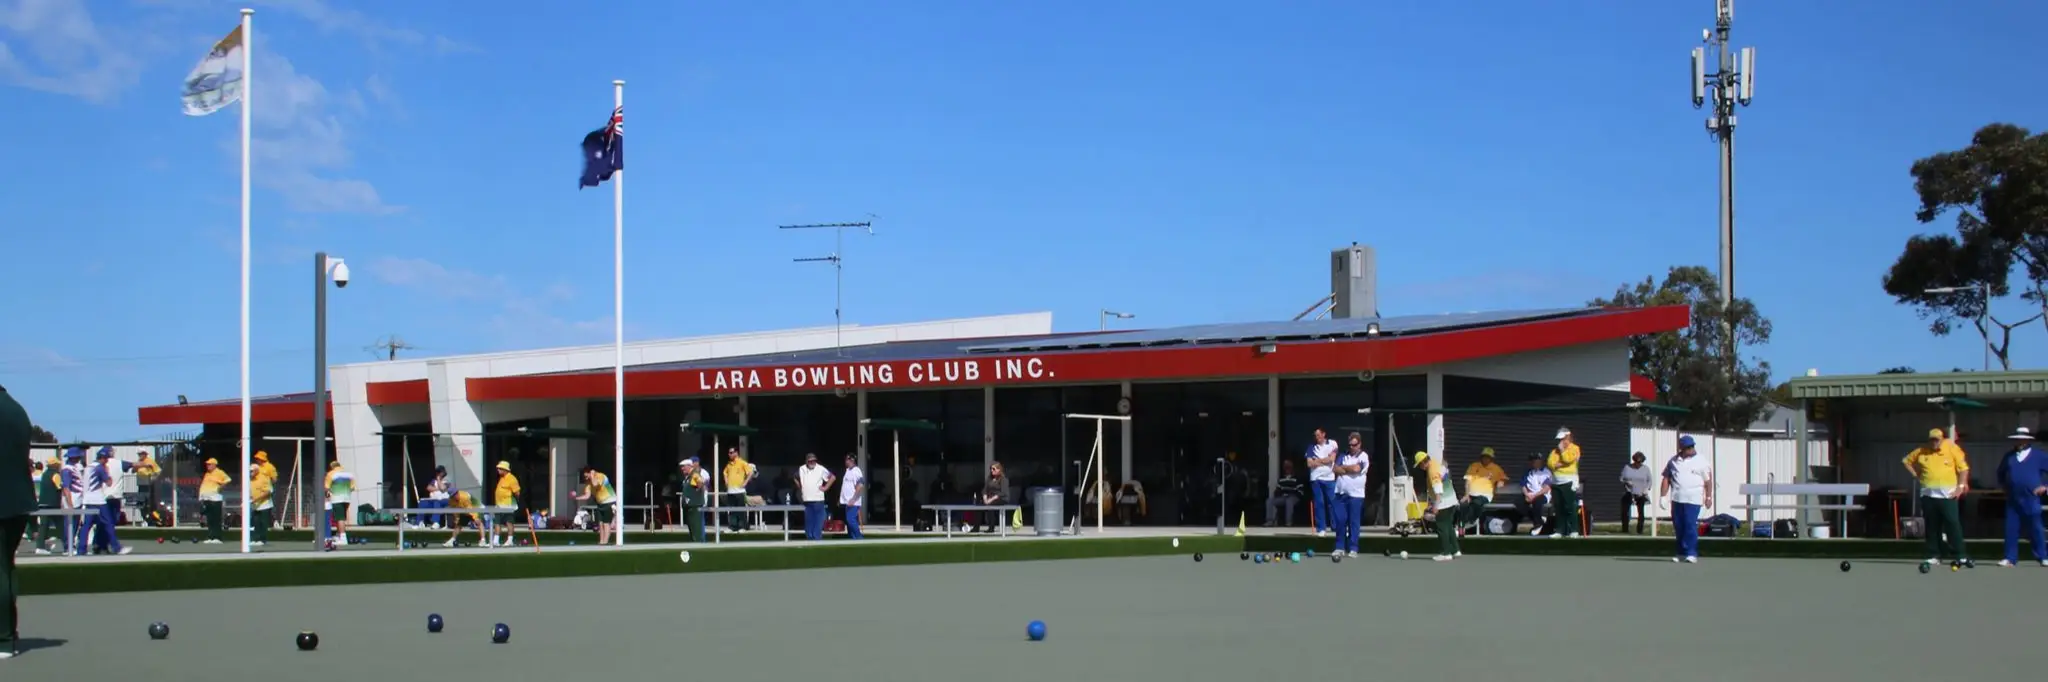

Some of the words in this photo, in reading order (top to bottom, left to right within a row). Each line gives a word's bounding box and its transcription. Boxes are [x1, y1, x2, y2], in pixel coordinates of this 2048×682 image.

[700, 369, 762, 390] LARA
[775, 363, 894, 388] BOWLING
[908, 361, 981, 383] CLUB
[995, 358, 1055, 380] INC.
